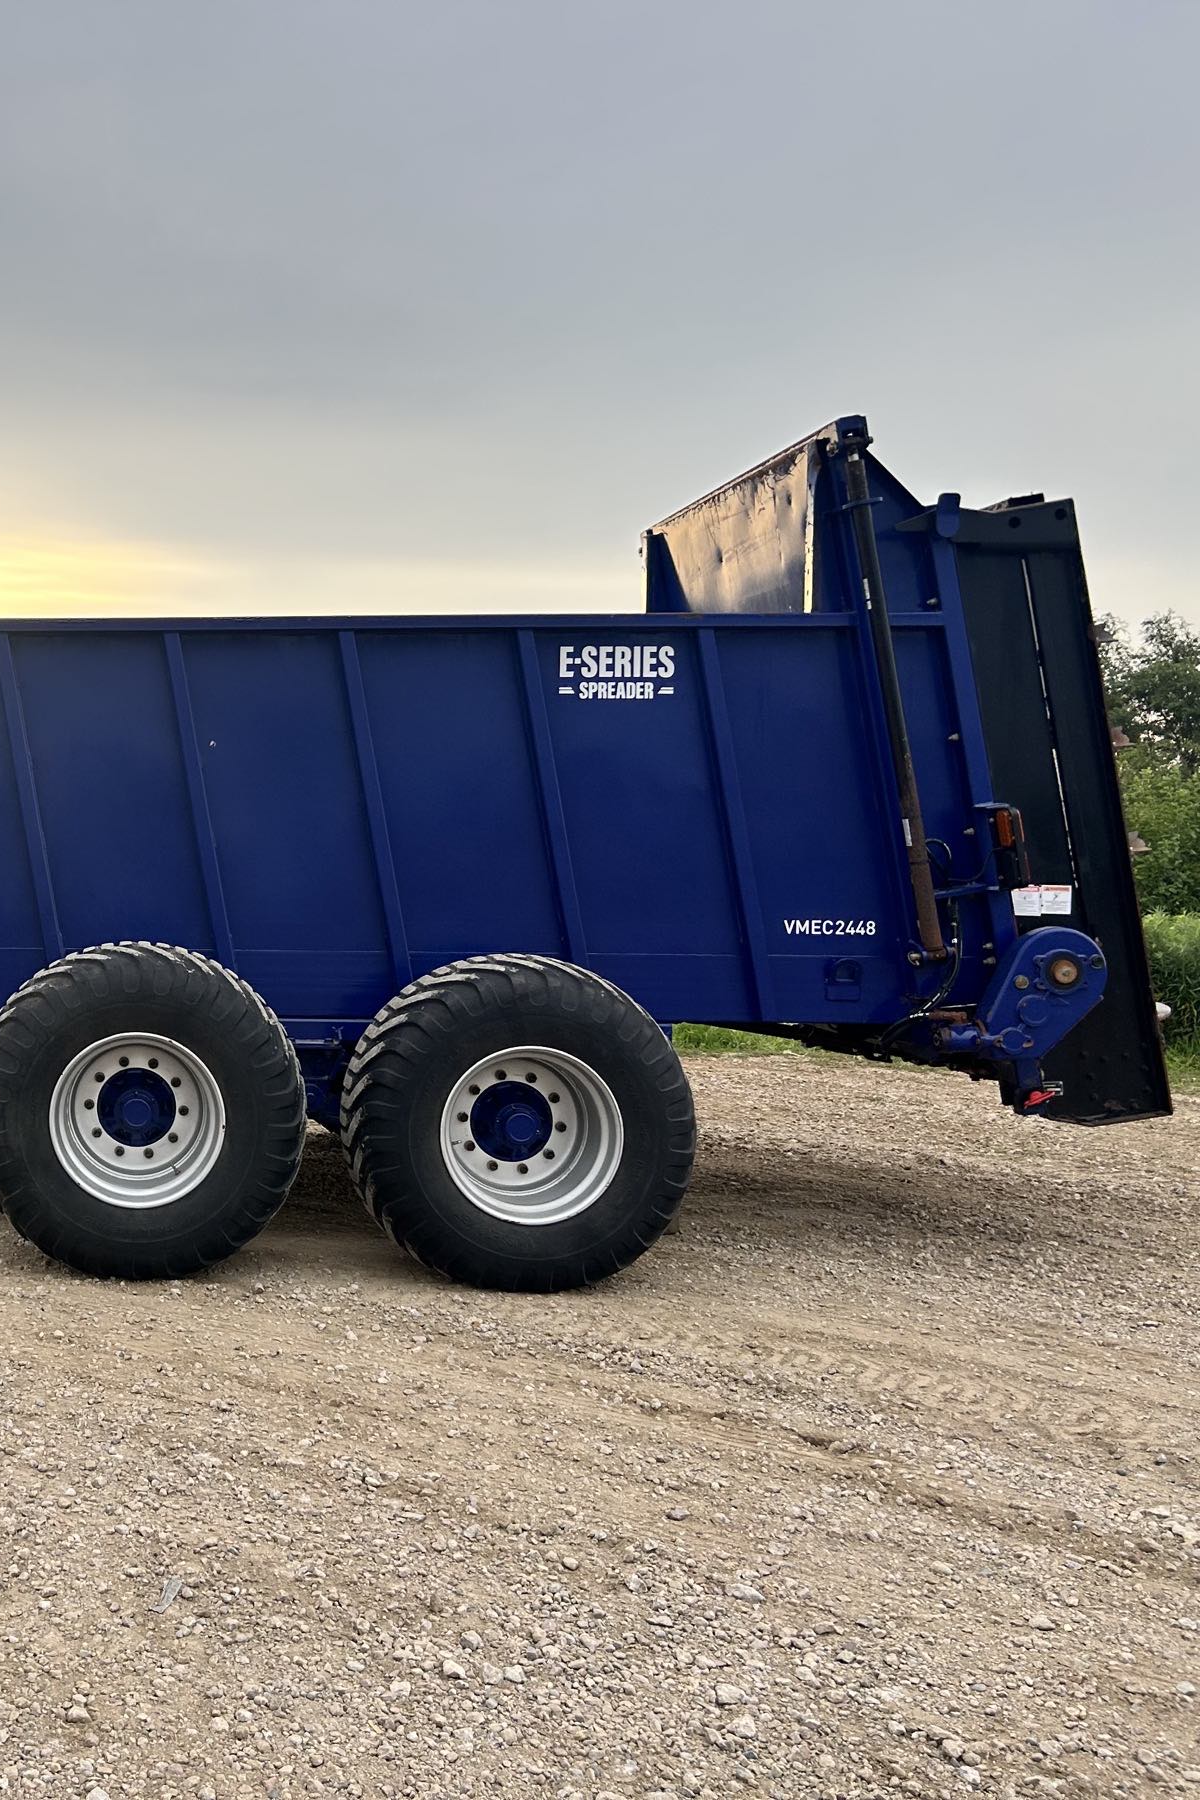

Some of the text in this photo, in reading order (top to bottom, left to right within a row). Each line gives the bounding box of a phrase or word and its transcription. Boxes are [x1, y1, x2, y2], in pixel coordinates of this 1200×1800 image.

[560, 646, 675, 678] E-SERIES
[579, 682, 654, 699] SPREADER
[784, 920, 876, 935] VMEC2448
